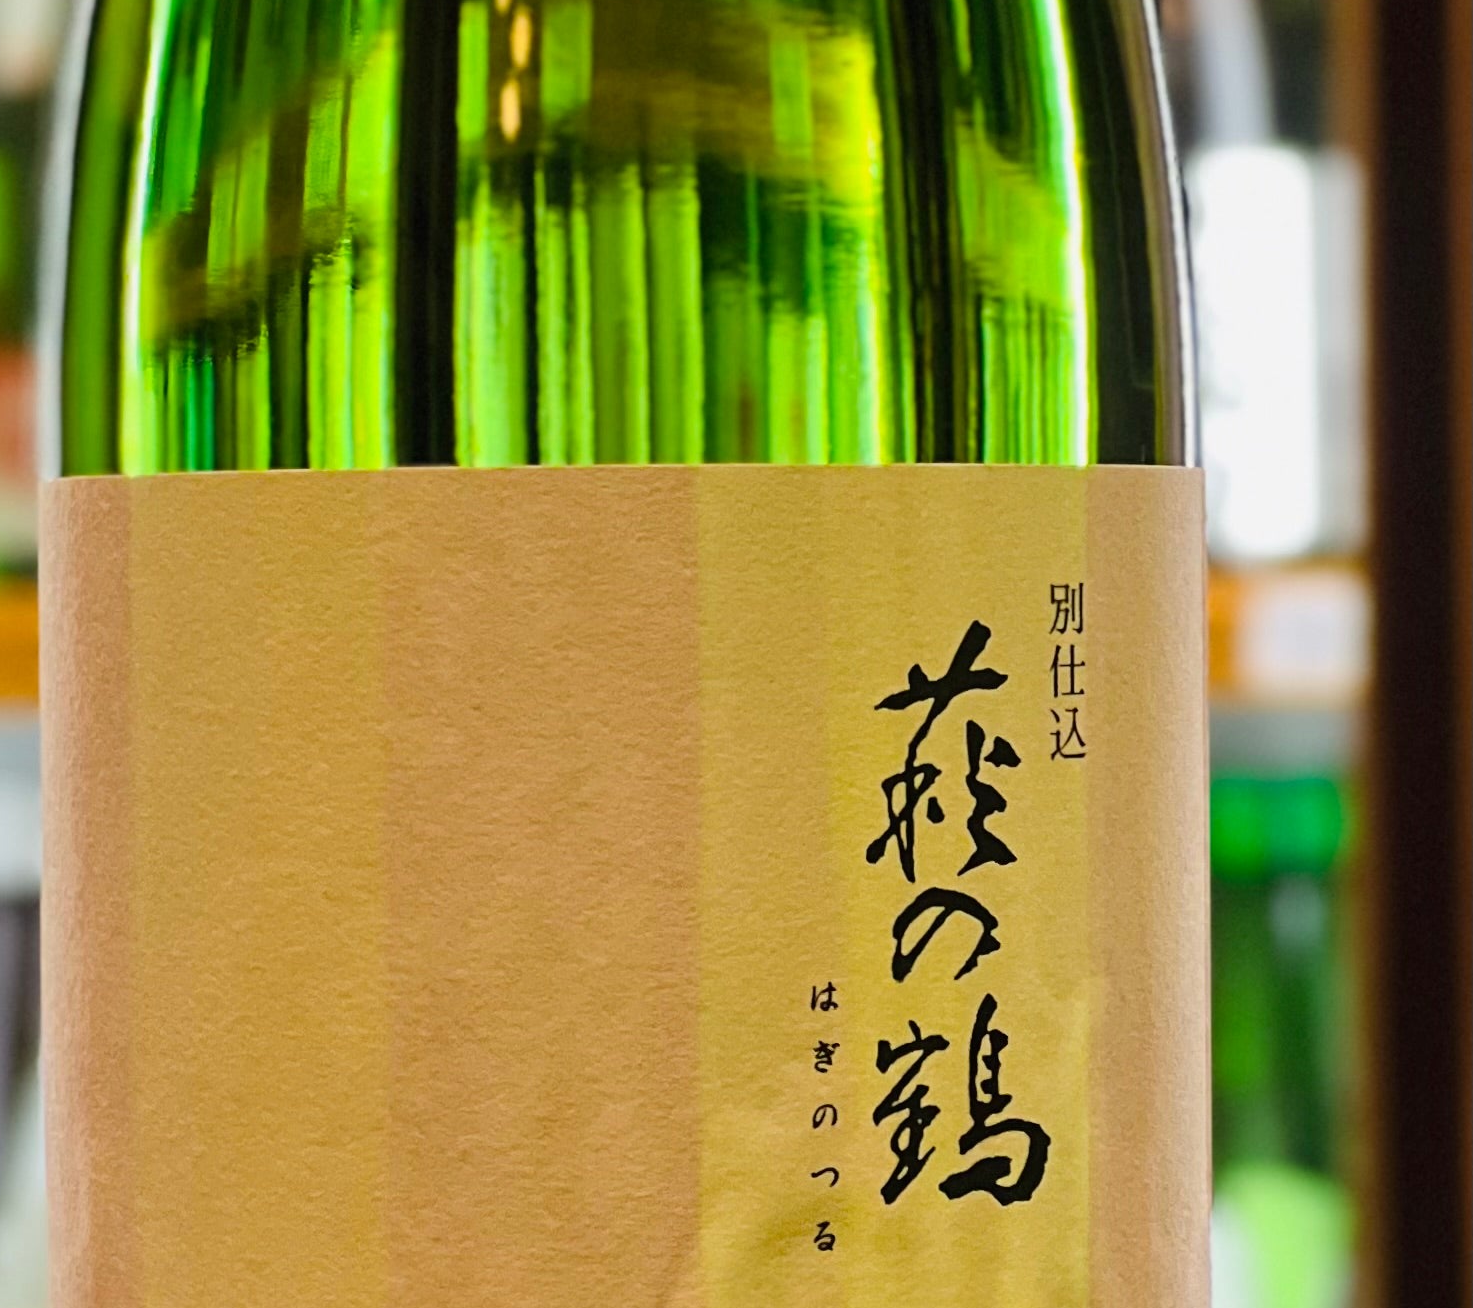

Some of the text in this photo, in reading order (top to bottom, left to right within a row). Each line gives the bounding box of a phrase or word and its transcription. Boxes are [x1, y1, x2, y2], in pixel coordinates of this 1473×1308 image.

[1048, 582, 1086, 761] 別仕込
[865, 620, 1051, 1207] 萩の鶴
[809, 982, 839, 1252] はぎのつる
